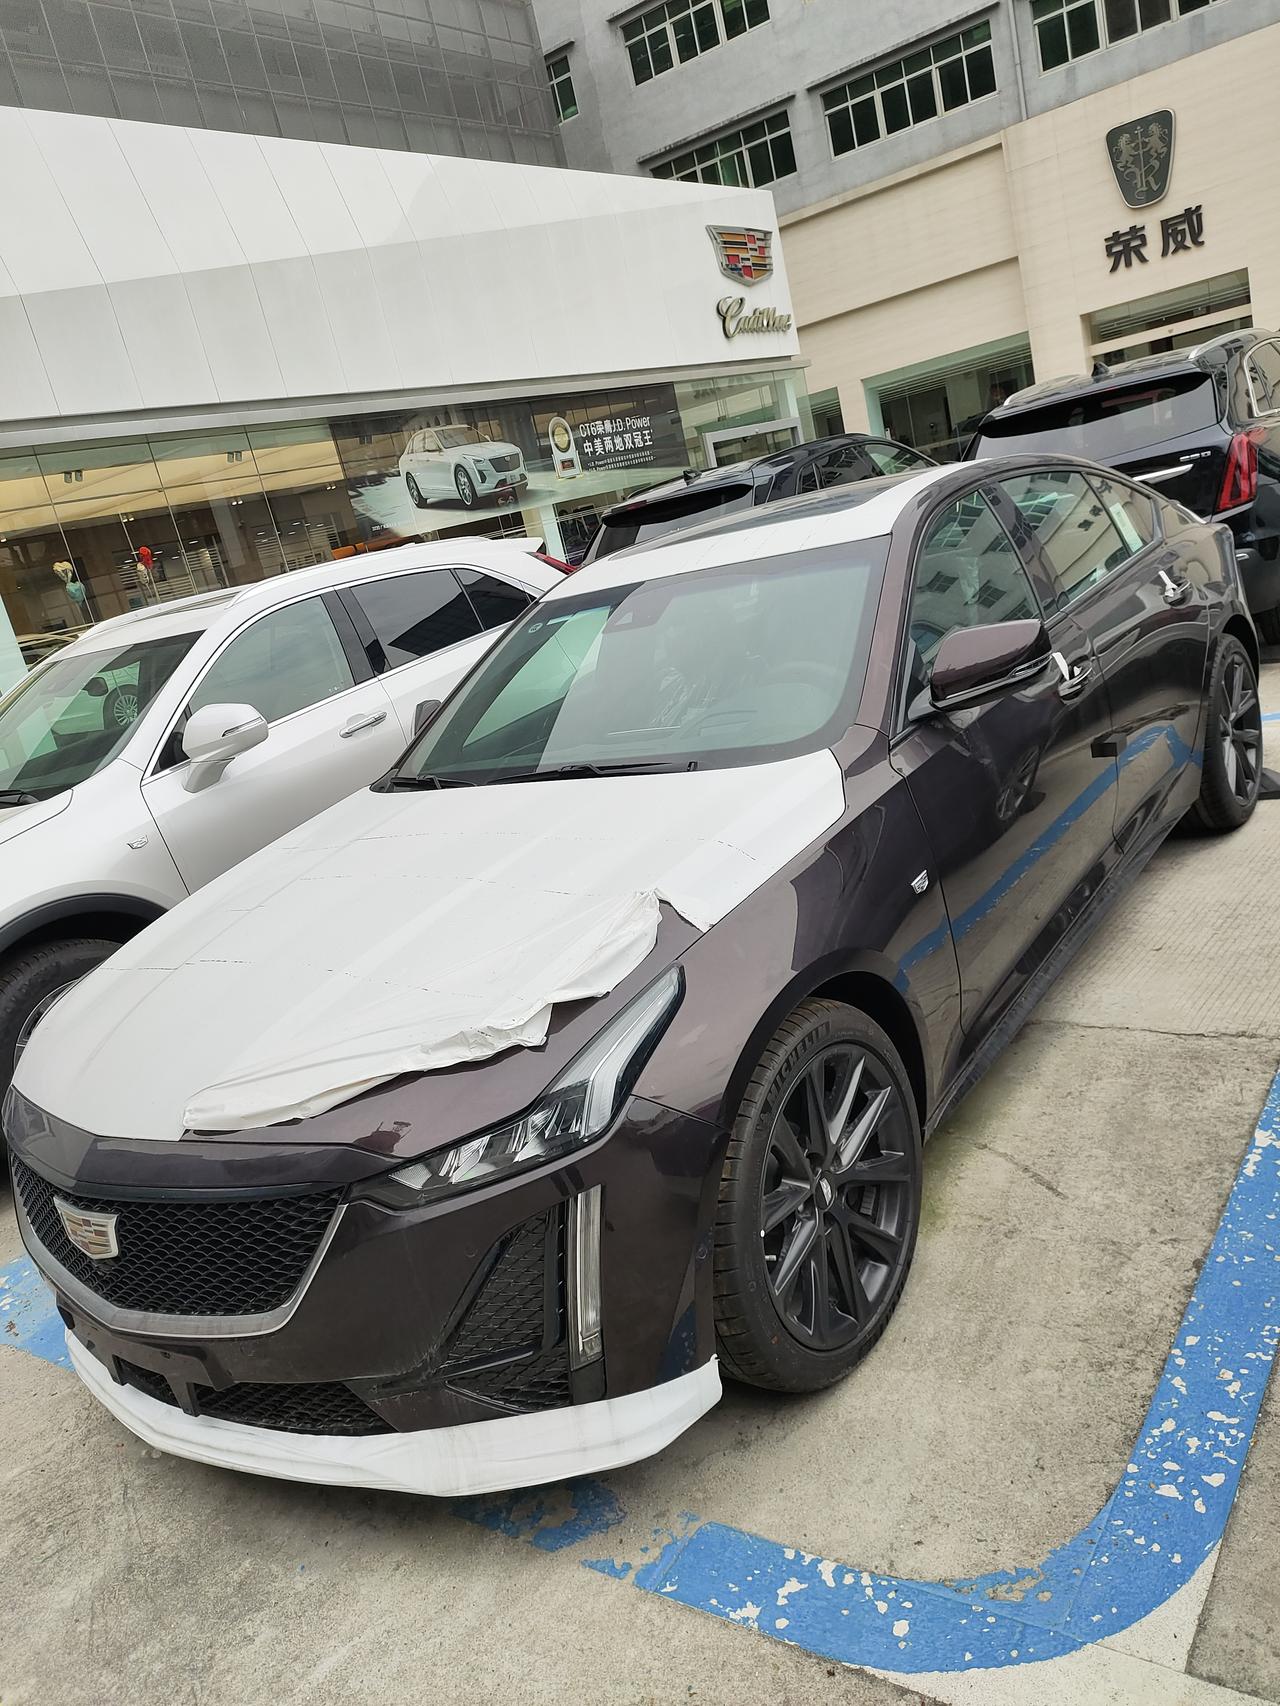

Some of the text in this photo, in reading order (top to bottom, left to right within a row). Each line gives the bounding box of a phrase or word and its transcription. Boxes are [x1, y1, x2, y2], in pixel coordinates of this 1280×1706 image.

[1104, 204, 1205, 273] 荣威
[716, 296, 792, 339] Cadillac
[767, 1020, 831, 1107] MICHELIN
